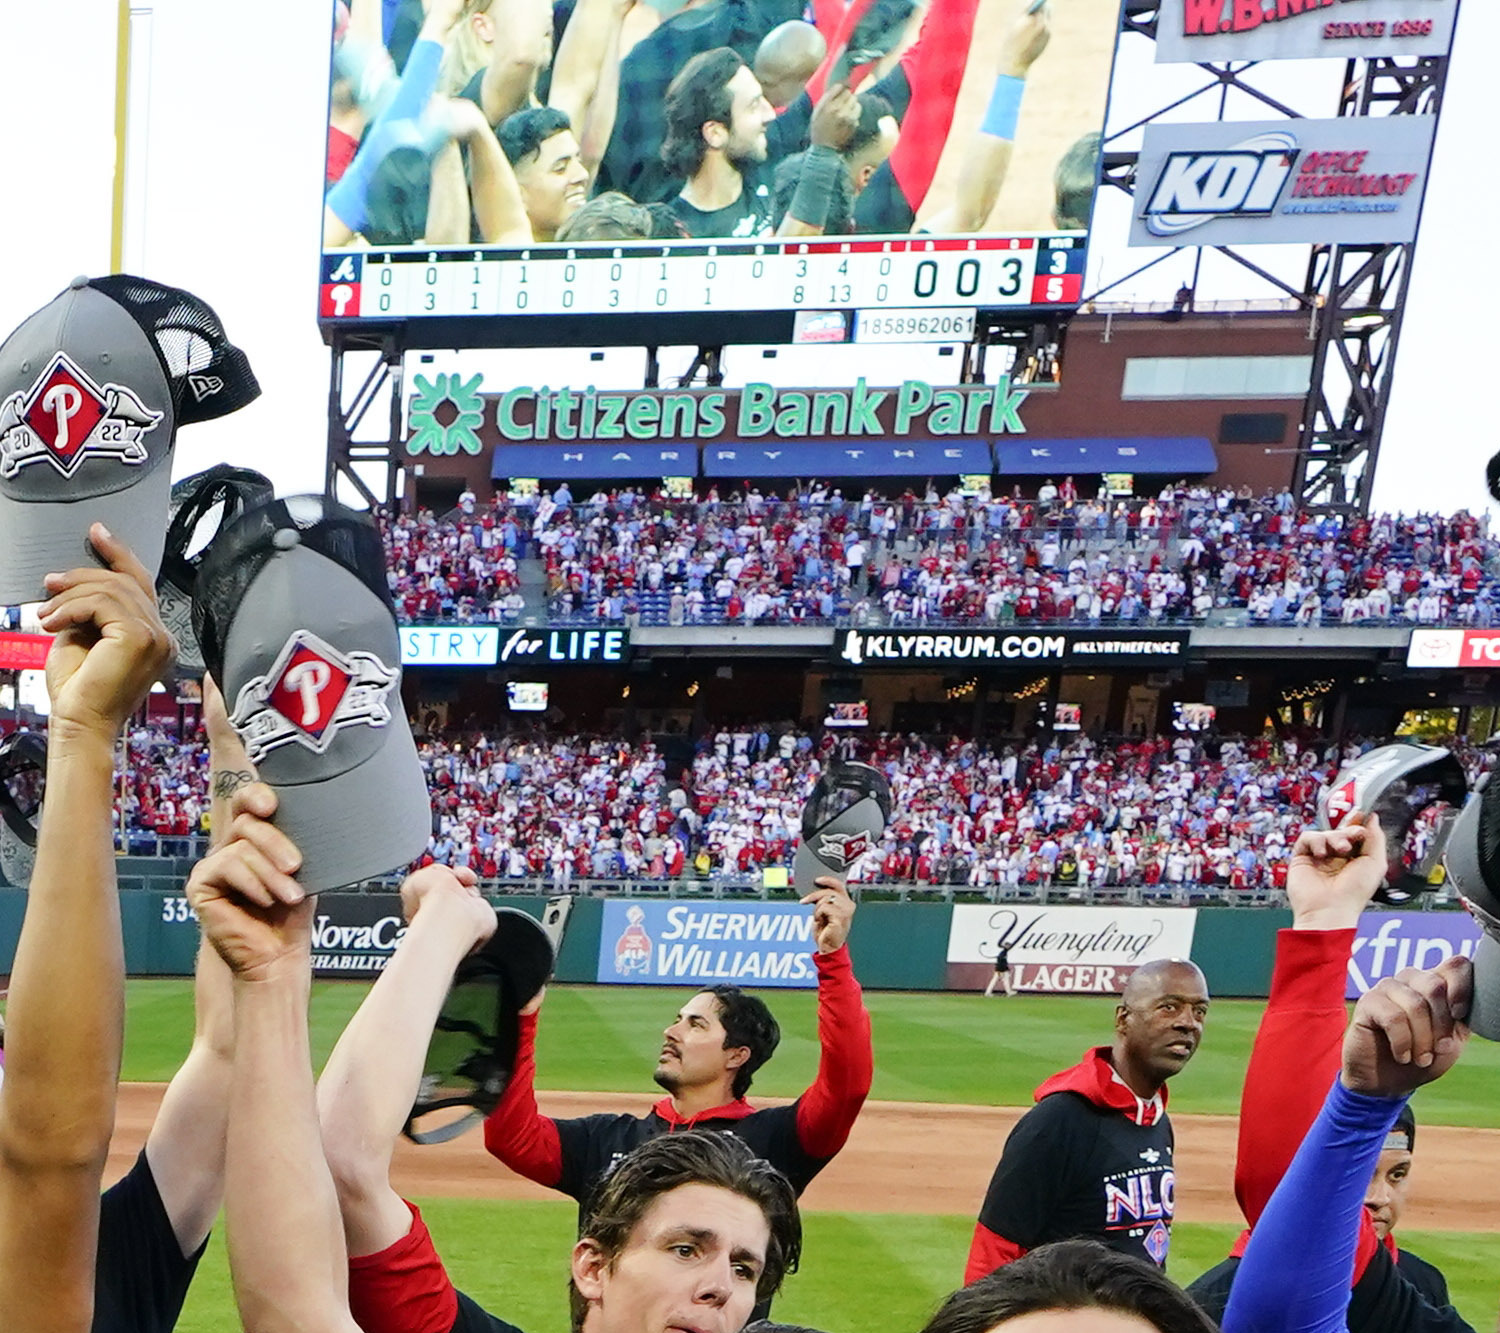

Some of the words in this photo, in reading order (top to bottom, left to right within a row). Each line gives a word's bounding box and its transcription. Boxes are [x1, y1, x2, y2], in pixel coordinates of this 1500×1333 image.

[1300, 150, 1369, 174] OFFICE
[1290, 173, 1418, 198] TECHNOLOGY
[1048, 252, 1069, 275] 3
[380, 268, 393, 287] 0
[426, 267, 438, 285] 0
[473, 266, 481, 284] 1
[520, 265, 528, 283] 1
[564, 265, 576, 282] 0
[610, 263, 622, 281] 0
[659, 262, 668, 281] 1
[705, 261, 717, 280] 0
[752, 260, 764, 278] 0
[796, 260, 808, 278] 3
[838, 259, 849, 275] 4
[879, 258, 891, 276] 0
[914, 260, 938, 298] 0
[956, 259, 981, 297] 0
[998, 258, 1023, 297] 3
[1045, 277, 1064, 302] 5
[379, 293, 391, 312] 0
[424, 292, 436, 310] 3
[471, 292, 479, 310] 1
[516, 291, 528, 309] 0
[562, 290, 574, 308] 0
[609, 289, 620, 307] 3
[656, 288, 667, 306] 0
[703, 287, 712, 305] 1
[793, 285, 805, 304] 8
[829, 284, 852, 303] 13
[876, 284, 888, 302] 0
[860, 316, 974, 336] 1858962061
[41, 383, 84, 450] P
[497, 384, 727, 441] Citizens
[736, 377, 889, 437] Bank
[895, 375, 1031, 437] Park
[14, 432, 31, 450] 20
[101, 424, 122, 442] 22
[501, 629, 544, 662] for
[550, 631, 623, 660] LIFE
[866, 635, 1066, 658] KLYRRUM.COM
[283, 660, 331, 726] P
[661, 905, 816, 943] SHERWIN
[978, 910, 1166, 963] Yuengling
[1010, 963, 1116, 993] LAGER
